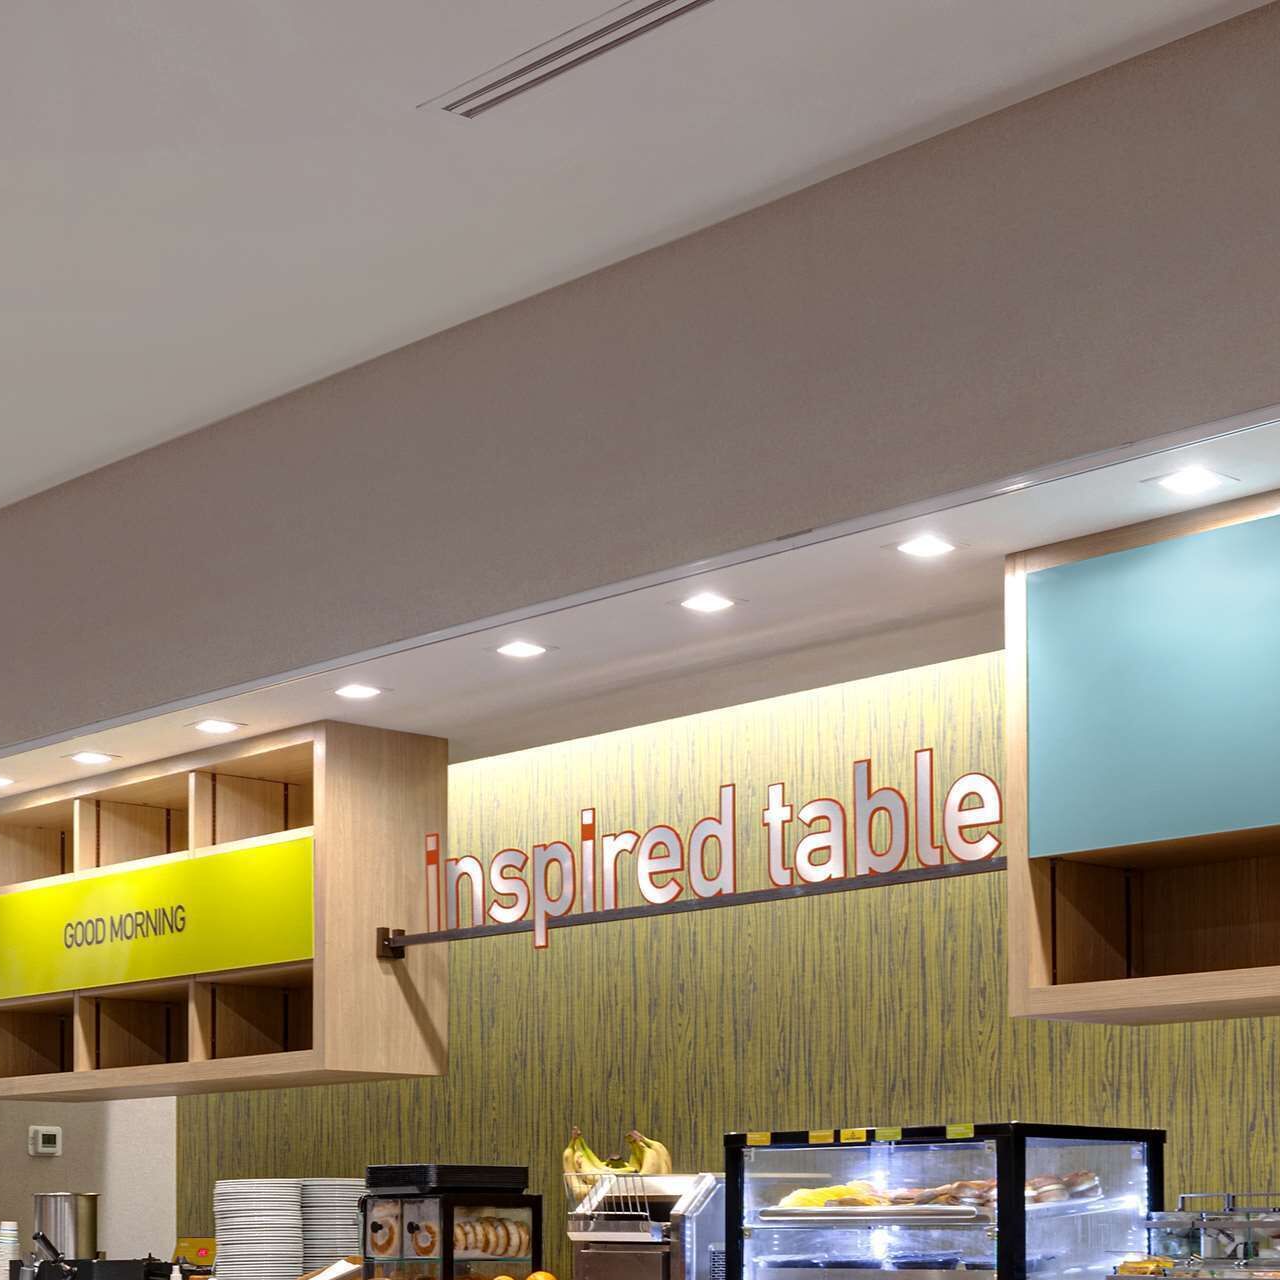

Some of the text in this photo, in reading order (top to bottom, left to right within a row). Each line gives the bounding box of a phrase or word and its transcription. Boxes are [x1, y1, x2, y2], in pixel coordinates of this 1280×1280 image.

[425, 748, 1003, 949] inspired table
[64, 904, 186, 949] GOOD MORNING
